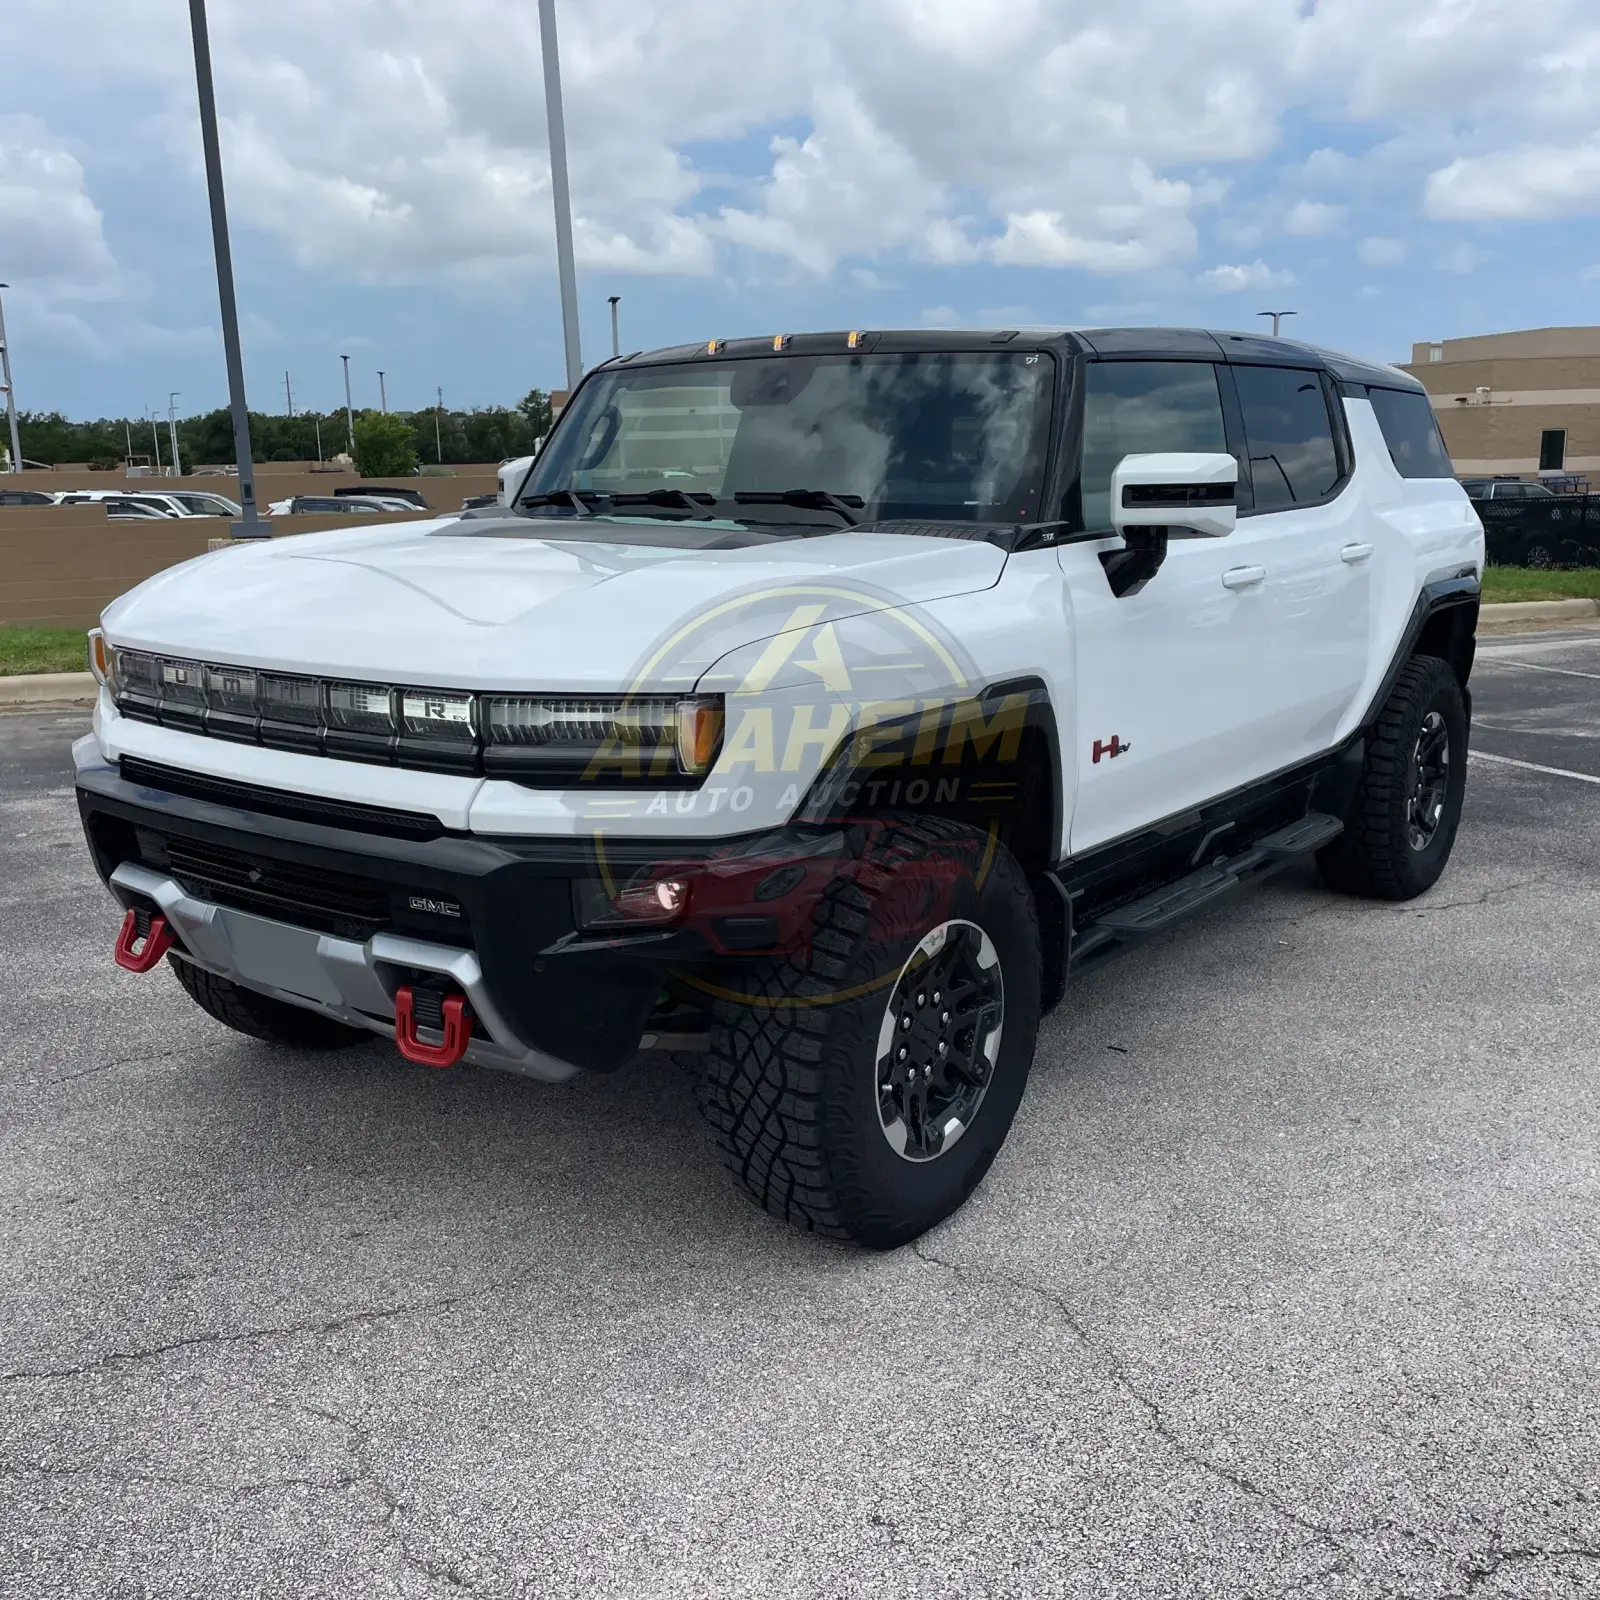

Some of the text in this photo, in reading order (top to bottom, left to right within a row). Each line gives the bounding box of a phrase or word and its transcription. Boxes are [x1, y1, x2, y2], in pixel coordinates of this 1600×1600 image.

[130, 661, 468, 722] UMMER EV
[409, 896, 461, 918] GMC
